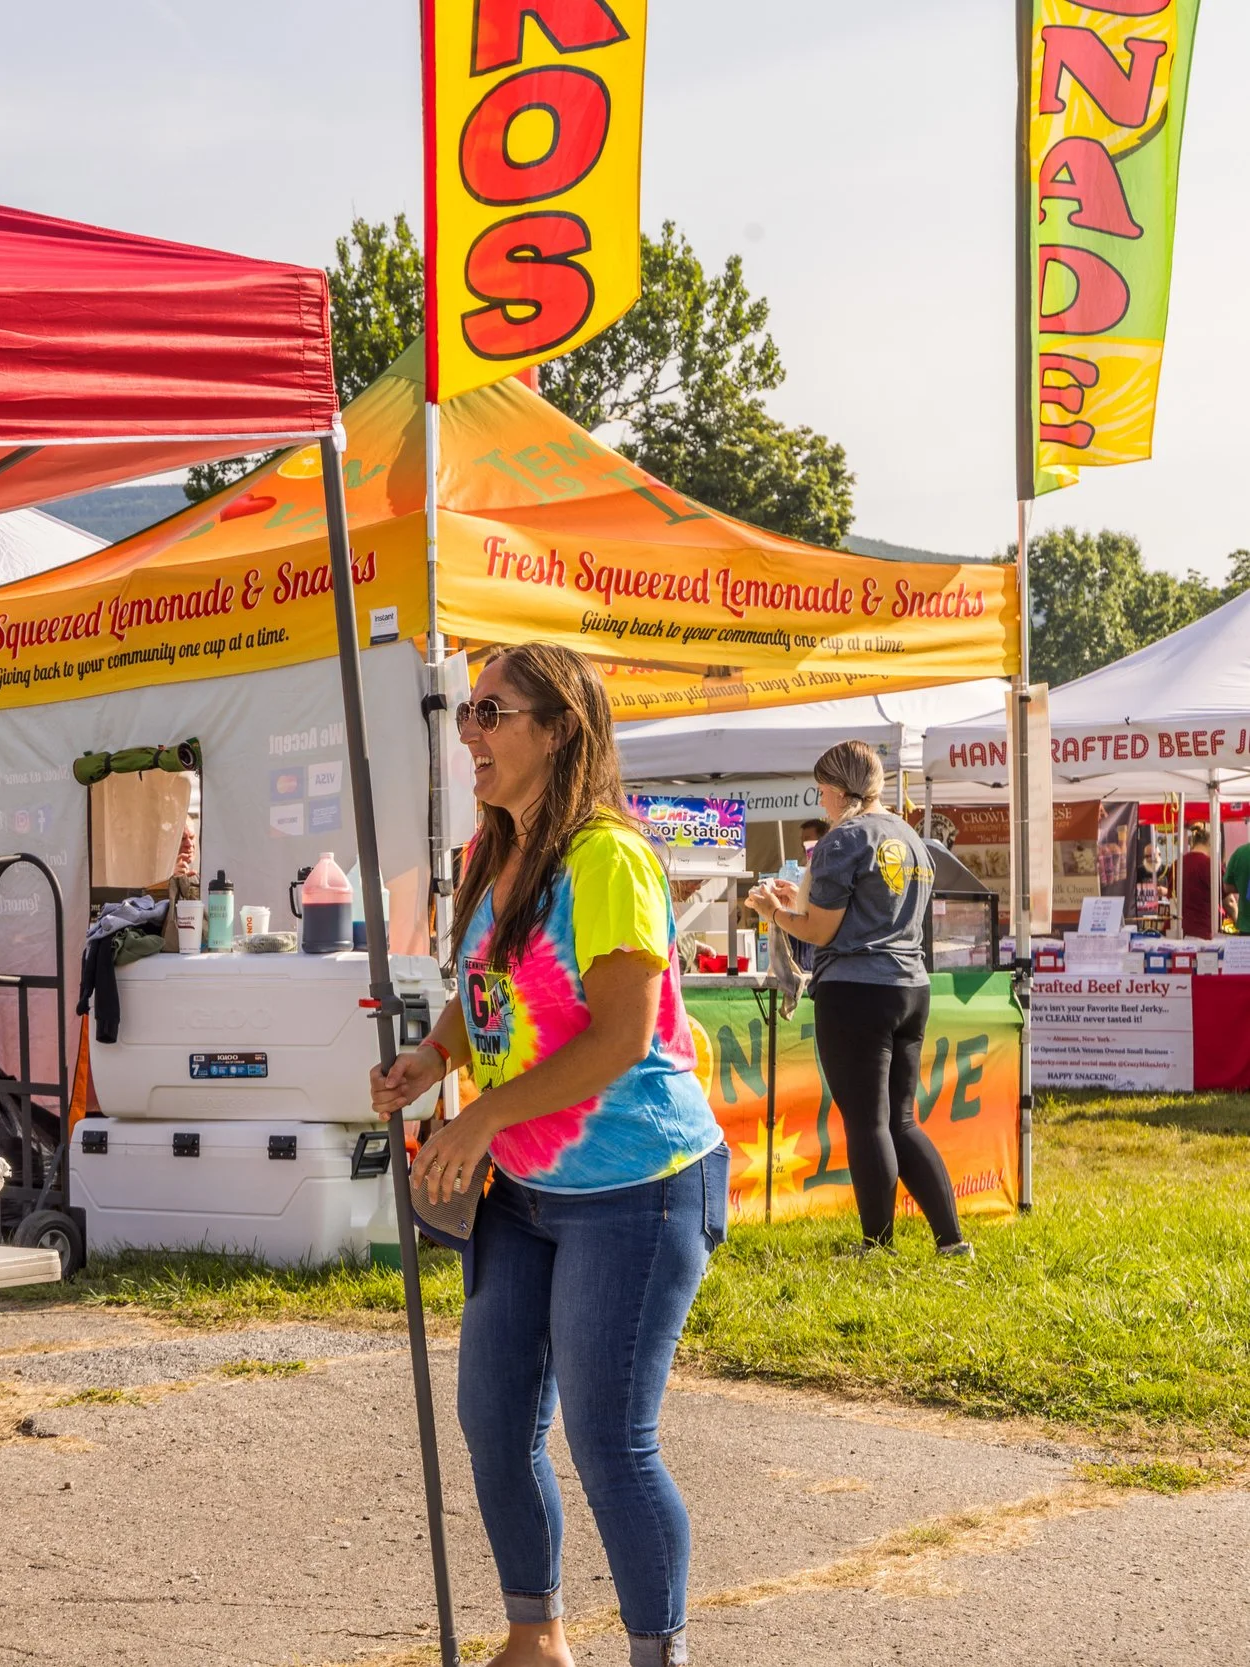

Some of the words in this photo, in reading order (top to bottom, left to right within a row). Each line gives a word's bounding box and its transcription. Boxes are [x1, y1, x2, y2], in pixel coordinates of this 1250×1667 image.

[1039, 0, 1174, 448] NADE
[483, 536, 565, 587] Fresh
[574, 551, 710, 605] Squeezed
[716, 568, 853, 619] Lemonade
[861, 584, 885, 616] &
[892, 582, 986, 619] Snacks
[107, 577, 234, 642] Lemonade
[242, 570, 264, 610] &
[272, 547, 377, 606] Snaks
[580, 610, 628, 638] Giving
[629, 615, 664, 639] back
[665, 621, 681, 639] to
[682, 625, 715, 646] your
[717, 627, 791, 652] community
[793, 632, 817, 649] one
[820, 634, 844, 656] cup
[846, 634, 862, 651] at
[863, 636, 874, 651] a
[875, 633, 906, 653] time.
[32, 660, 61, 684] back
[62, 659, 75, 679] to
[77, 657, 105, 682] your
[107, 641, 177, 674] community
[179, 640, 202, 660] one
[203, 638, 226, 661] cup
[228, 633, 244, 653] at
[245, 635, 255, 651] a
[255, 626, 290, 650] time.
[950, 733, 1149, 768] HANRAFTED
[1158, 729, 1225, 758] BEEF
[738, 789, 799, 811] Vermont
[683, 823, 740, 838] Station
[1088, 979, 1122, 993] Beef
[1126, 979, 1170, 997] Jerky
[468, 973, 510, 1029] GARLIC
[1067, 1006, 1085, 1015] your
[1087, 1004, 1119, 1013] Favorite
[1121, 1004, 1138, 1013] Beef
[1045, 1014, 1081, 1023] CLEARLY
[1107, 1015, 1131, 1024] tasted
[474, 1033, 501, 1055] TOWN
[192, 1064, 200, 1076] 7
[1047, 1072, 1073, 1080] HAPPY
[1074, 1073, 1117, 1081] SNACKING!
